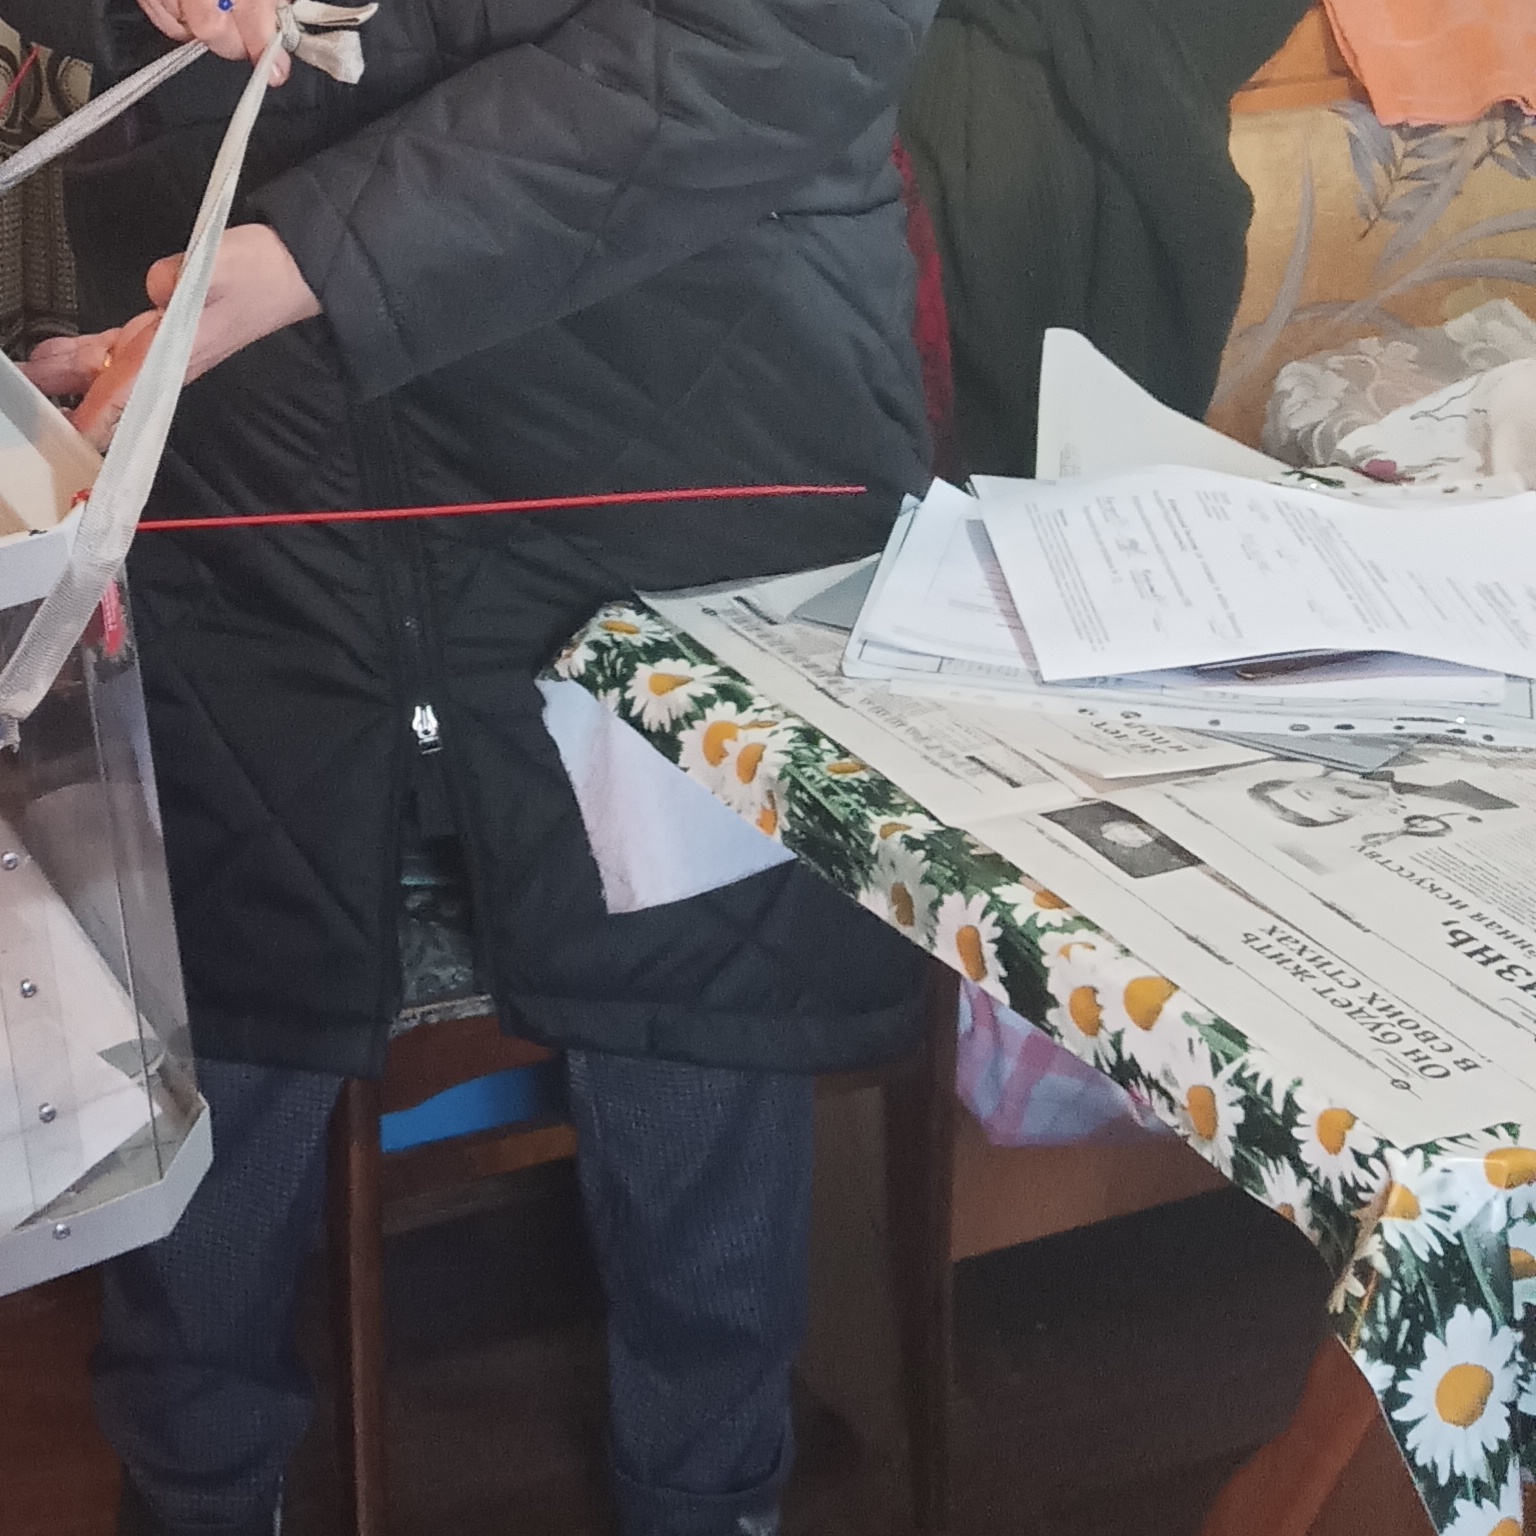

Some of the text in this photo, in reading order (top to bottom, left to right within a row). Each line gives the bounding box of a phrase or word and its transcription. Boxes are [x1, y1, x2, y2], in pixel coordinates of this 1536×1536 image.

[1241, 931, 1451, 1081] Он будет жить
[1258, 924, 1483, 1073] в своих стихах
